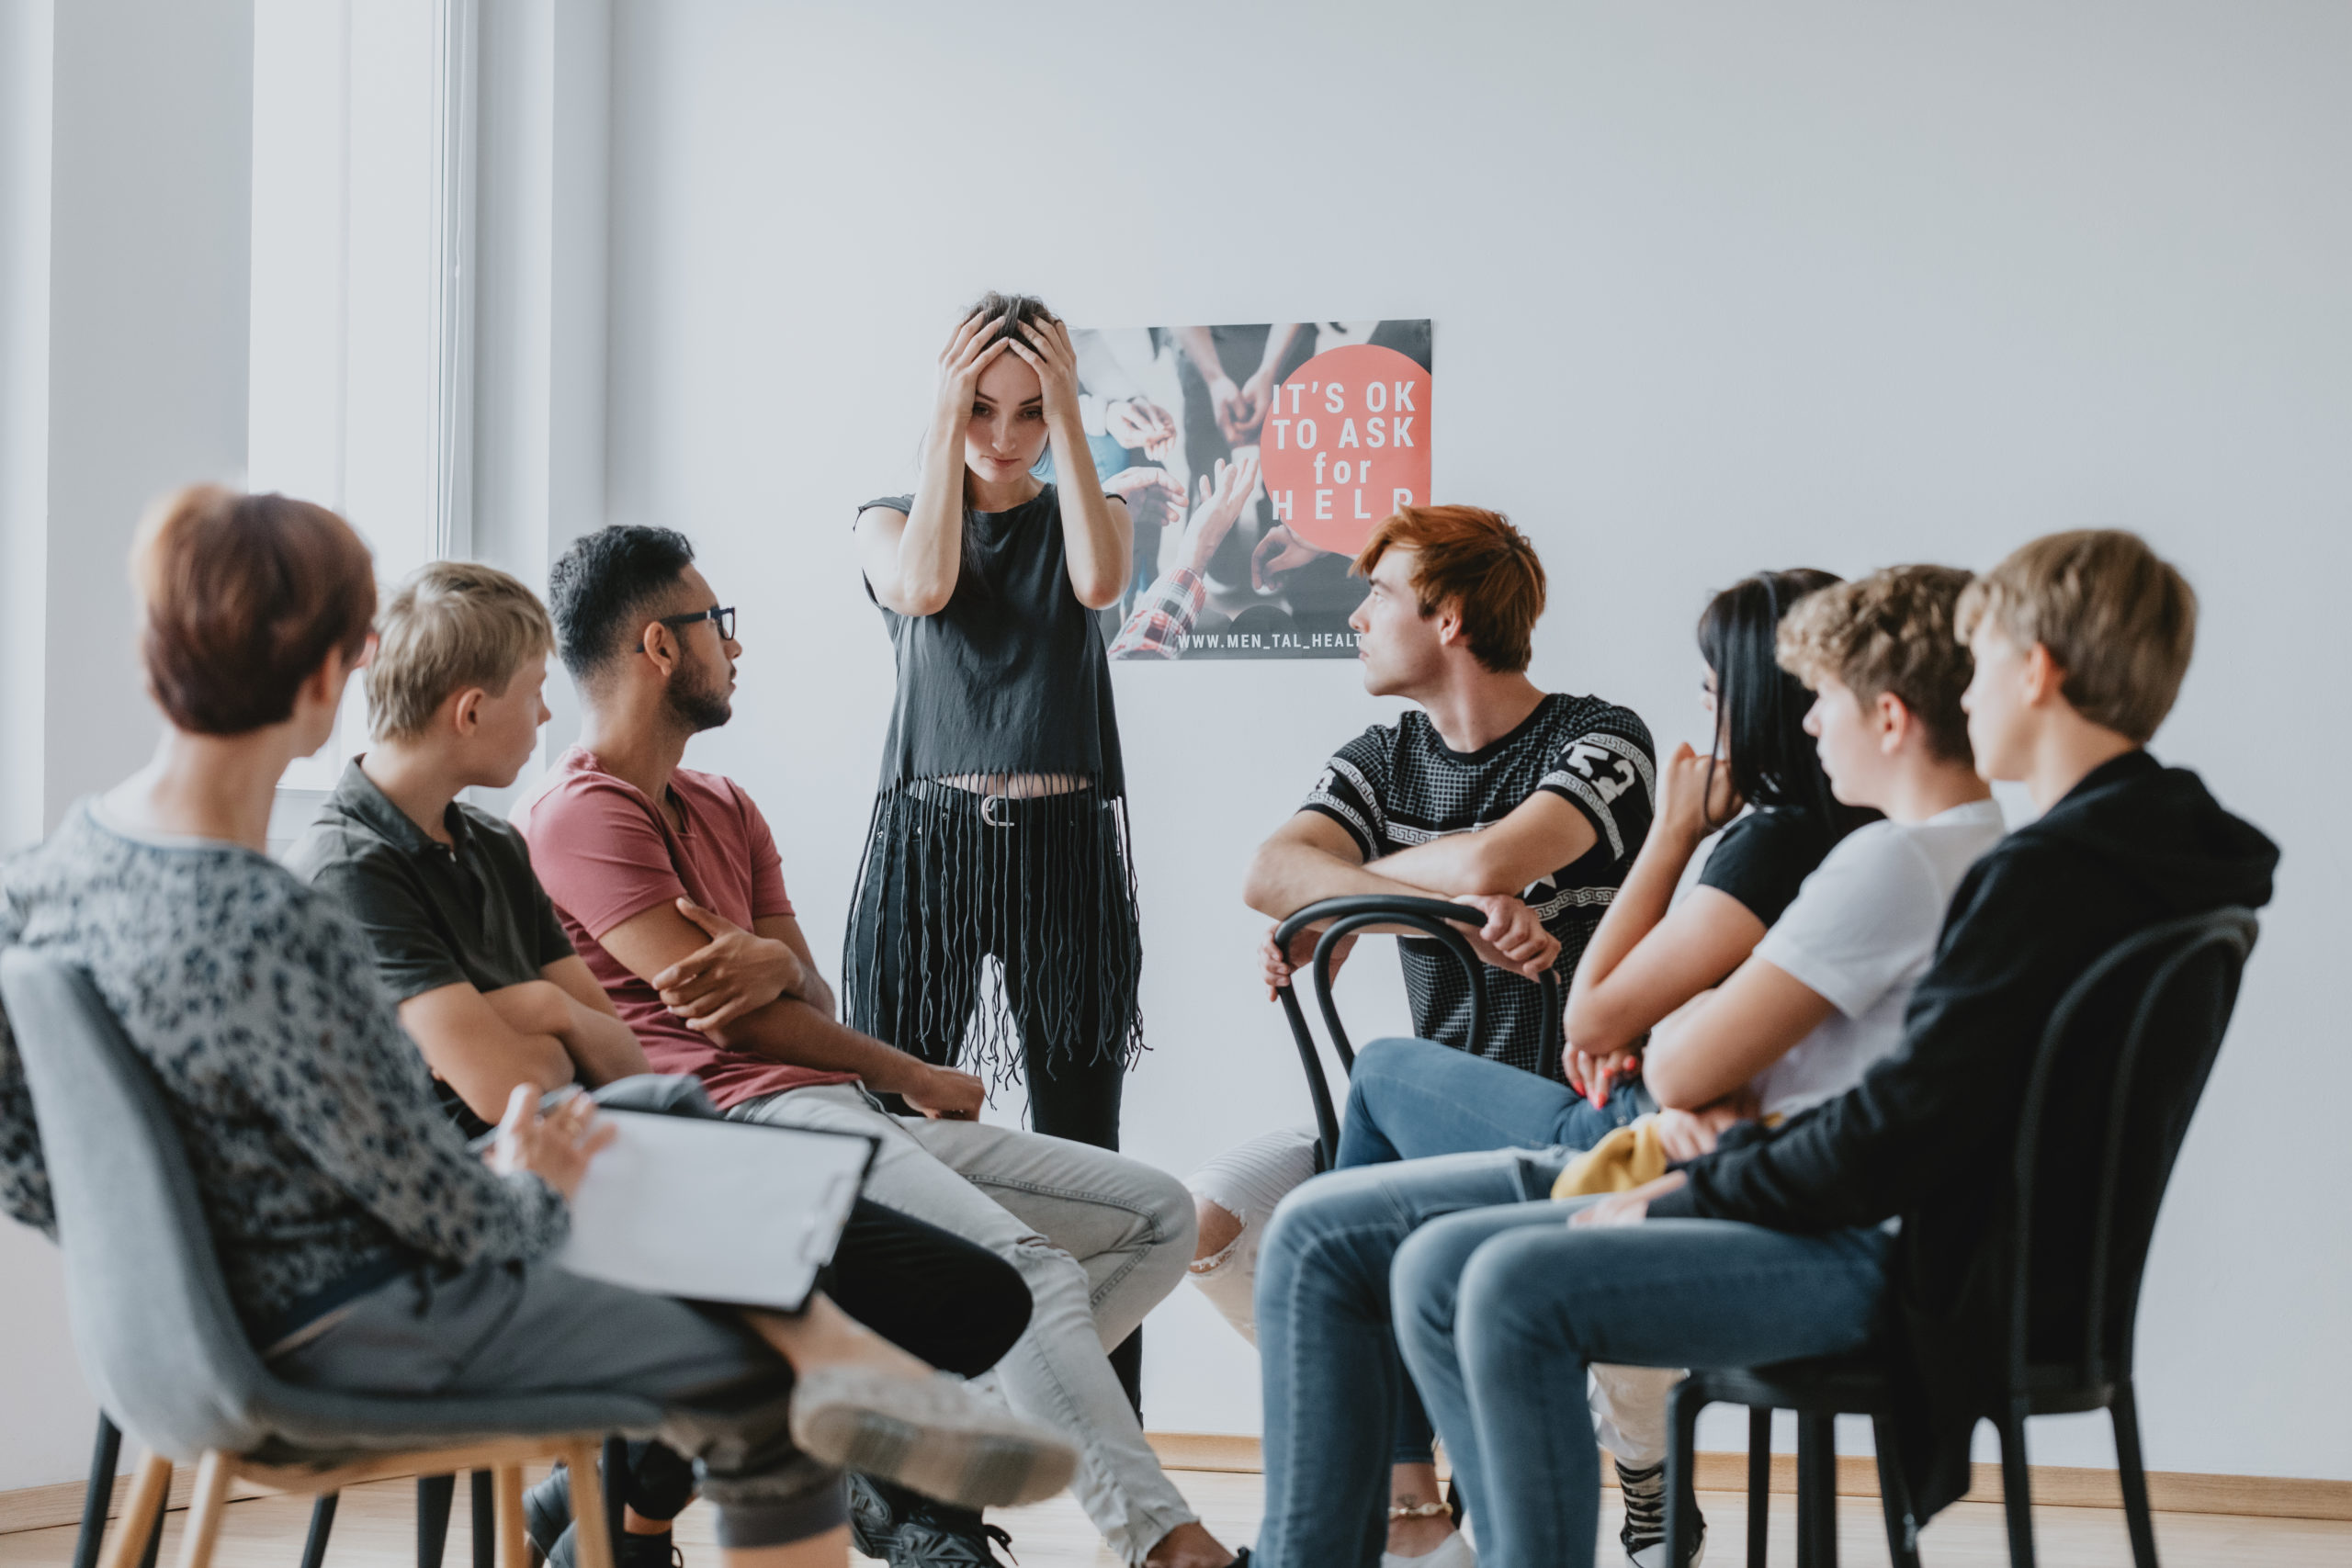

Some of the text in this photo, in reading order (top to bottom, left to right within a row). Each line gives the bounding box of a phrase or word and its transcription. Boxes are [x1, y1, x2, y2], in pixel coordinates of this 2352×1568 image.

[1272, 380, 1416, 415] IT'S OK
[1272, 417, 1414, 450] TO ASK
[1313, 451, 1372, 485] for
[1272, 488, 1413, 521] HELP
[1178, 633, 1363, 650] WWW.MEN_TAL_HEALT
